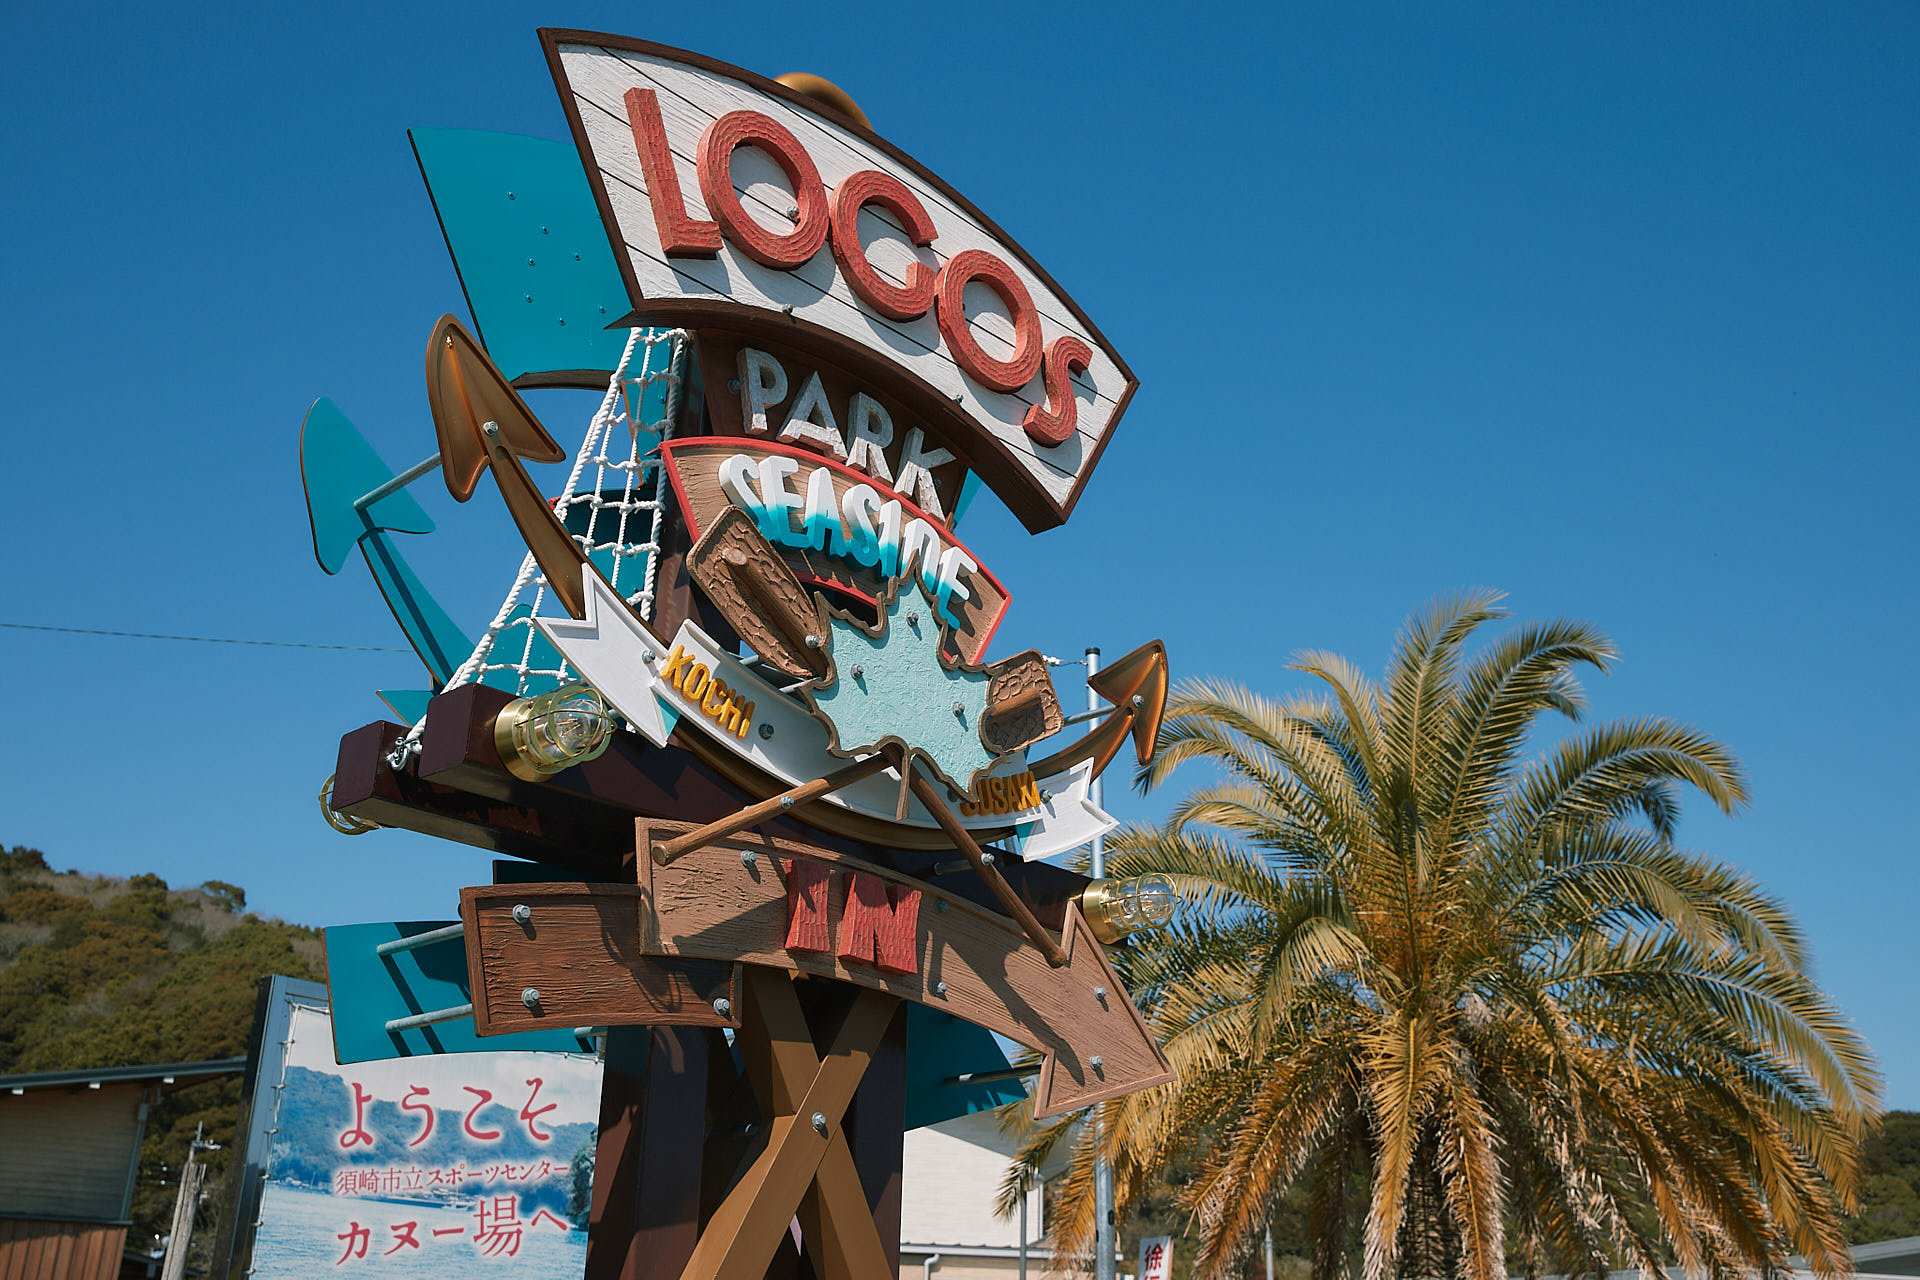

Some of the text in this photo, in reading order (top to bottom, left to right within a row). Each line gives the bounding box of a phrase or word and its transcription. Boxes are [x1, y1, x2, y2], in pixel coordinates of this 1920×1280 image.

[624, 87, 1092, 447] LOGOS
[737, 347, 956, 521] PARK
[660, 645, 755, 739] KOCHI
[785, 859, 922, 974] IN
[340, 1077, 557, 1148] ようこそ
[335, 1160, 568, 1195] 須崎市立スポーツセンター
[336, 1196, 567, 1266] カヌー場へ
